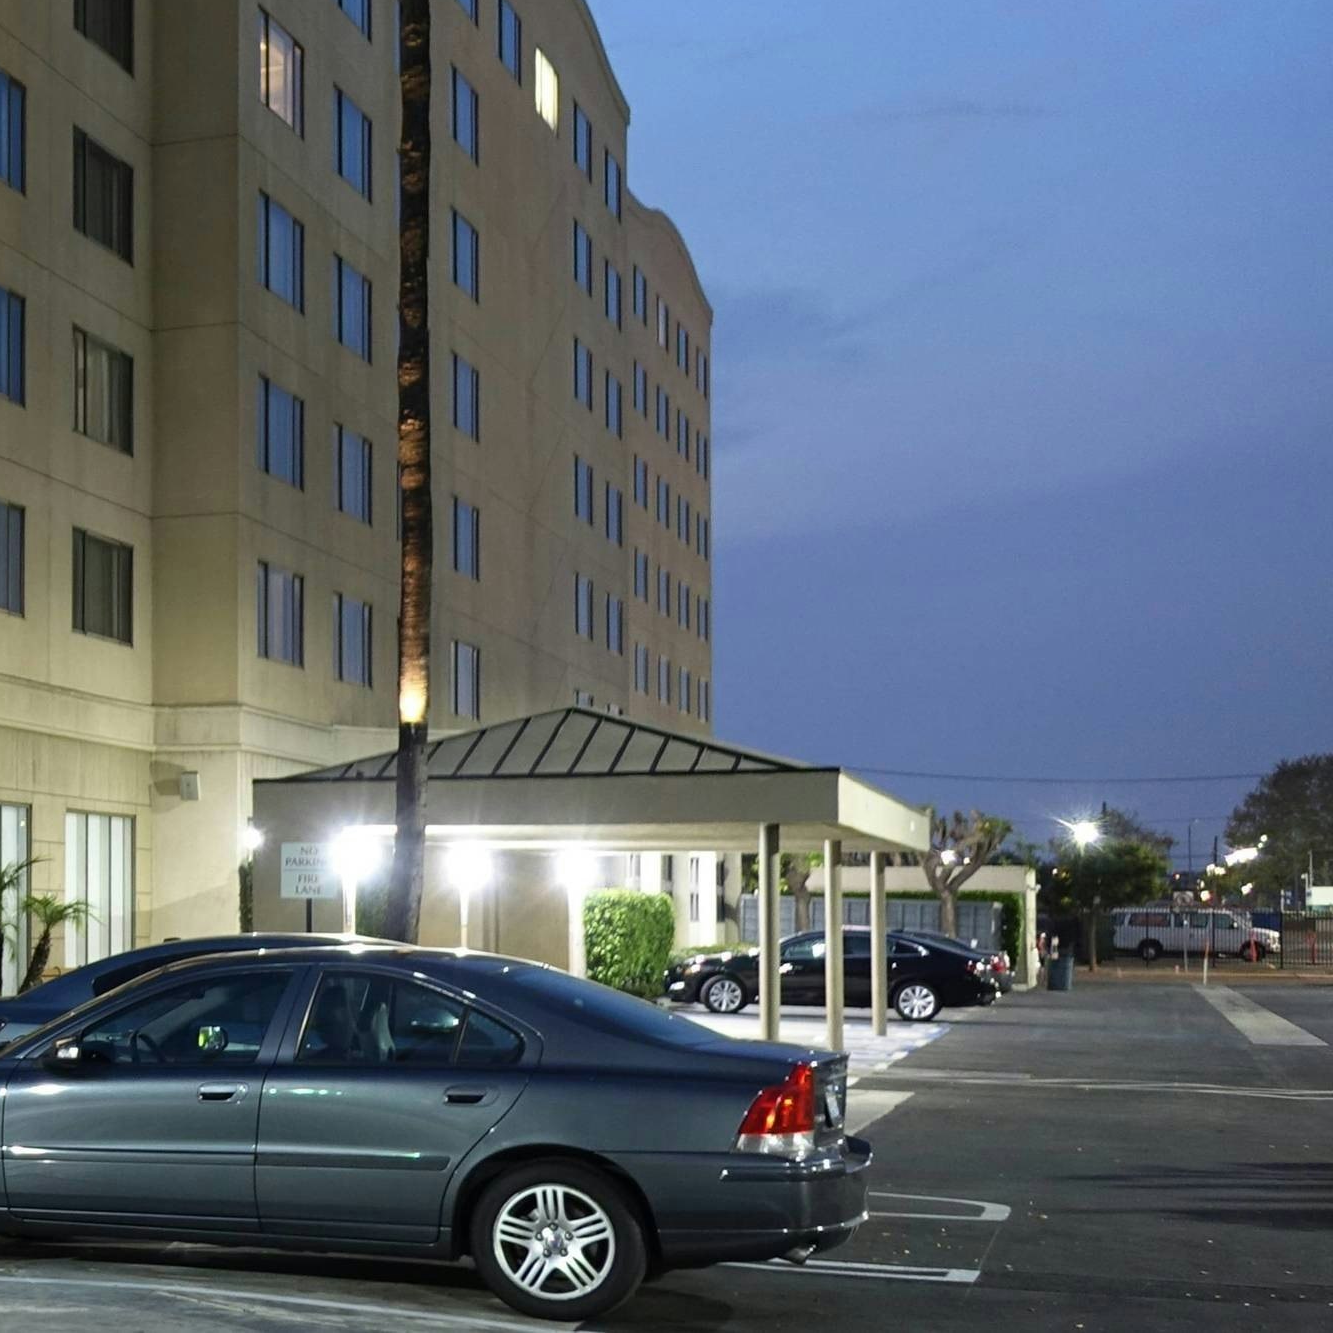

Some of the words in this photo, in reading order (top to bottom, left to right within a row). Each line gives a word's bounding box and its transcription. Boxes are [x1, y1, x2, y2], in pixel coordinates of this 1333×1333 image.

[300, 846, 318, 856] NO
[285, 857, 329, 867] PARKIN
[297, 873, 318, 883] FIRE
[295, 885, 321, 895] LANE
